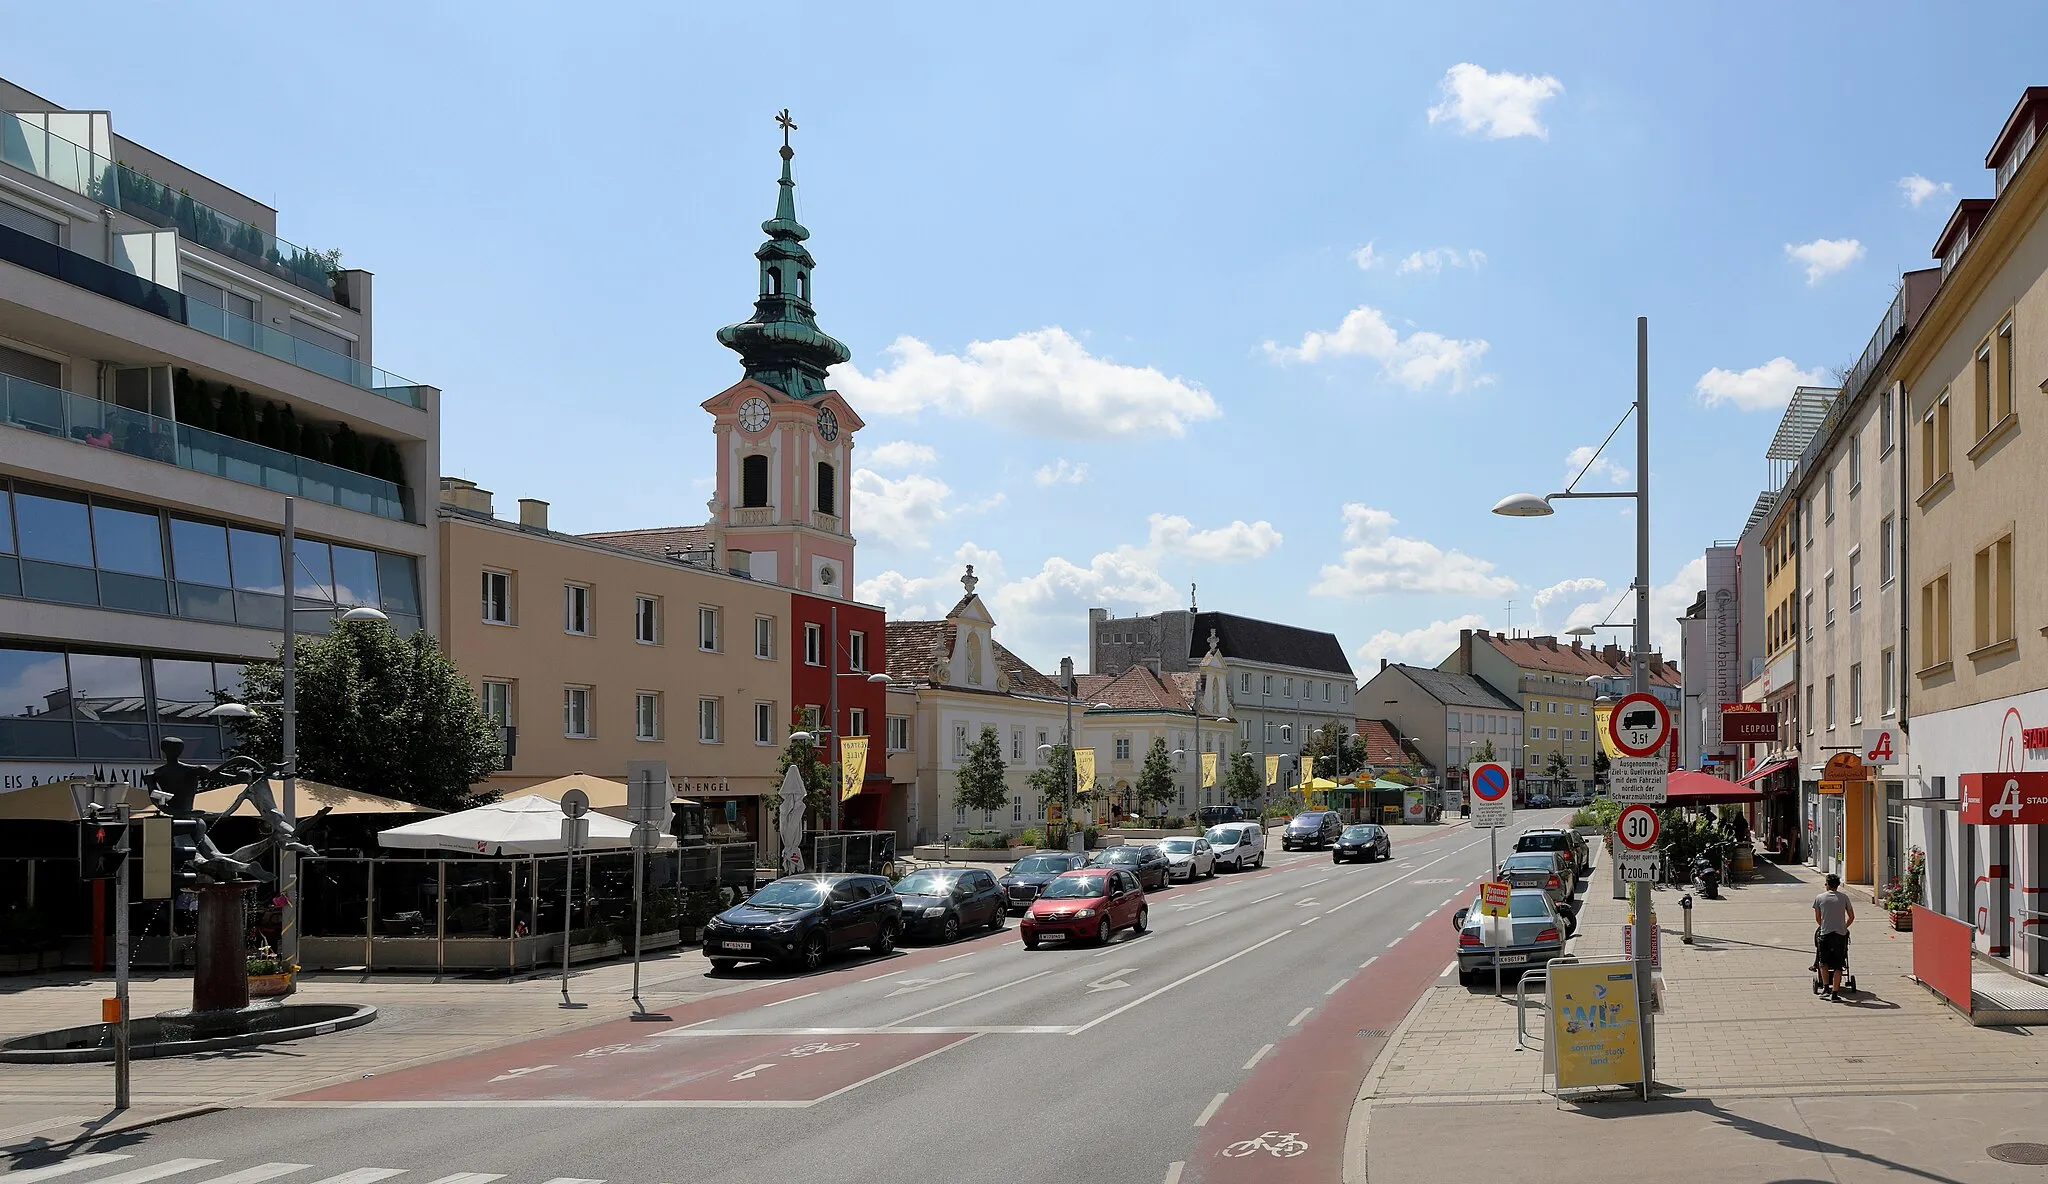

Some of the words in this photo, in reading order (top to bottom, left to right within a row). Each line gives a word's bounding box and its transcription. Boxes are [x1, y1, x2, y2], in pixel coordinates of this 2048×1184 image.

[1741, 724, 1775, 733] LEOPOLD
[1631, 731, 1649, 745] 3,5t
[1620, 760, 1658, 768] Ausgenommen
[4, 775, 22, 788] EIS
[31, 775, 39, 788] &
[1638, 776, 1662, 784] Fahrziel
[1611, 792, 1665, 800] Schwarzmühlstraße
[1628, 817, 1648, 838] 30
[1618, 853, 1641, 861] Fußgänger
[1628, 867, 1649, 879] 200m
[1487, 885, 1508, 896] Kronen
[1486, 893, 1506, 905] Zeitung
[1590, 1057, 1609, 1066] land
